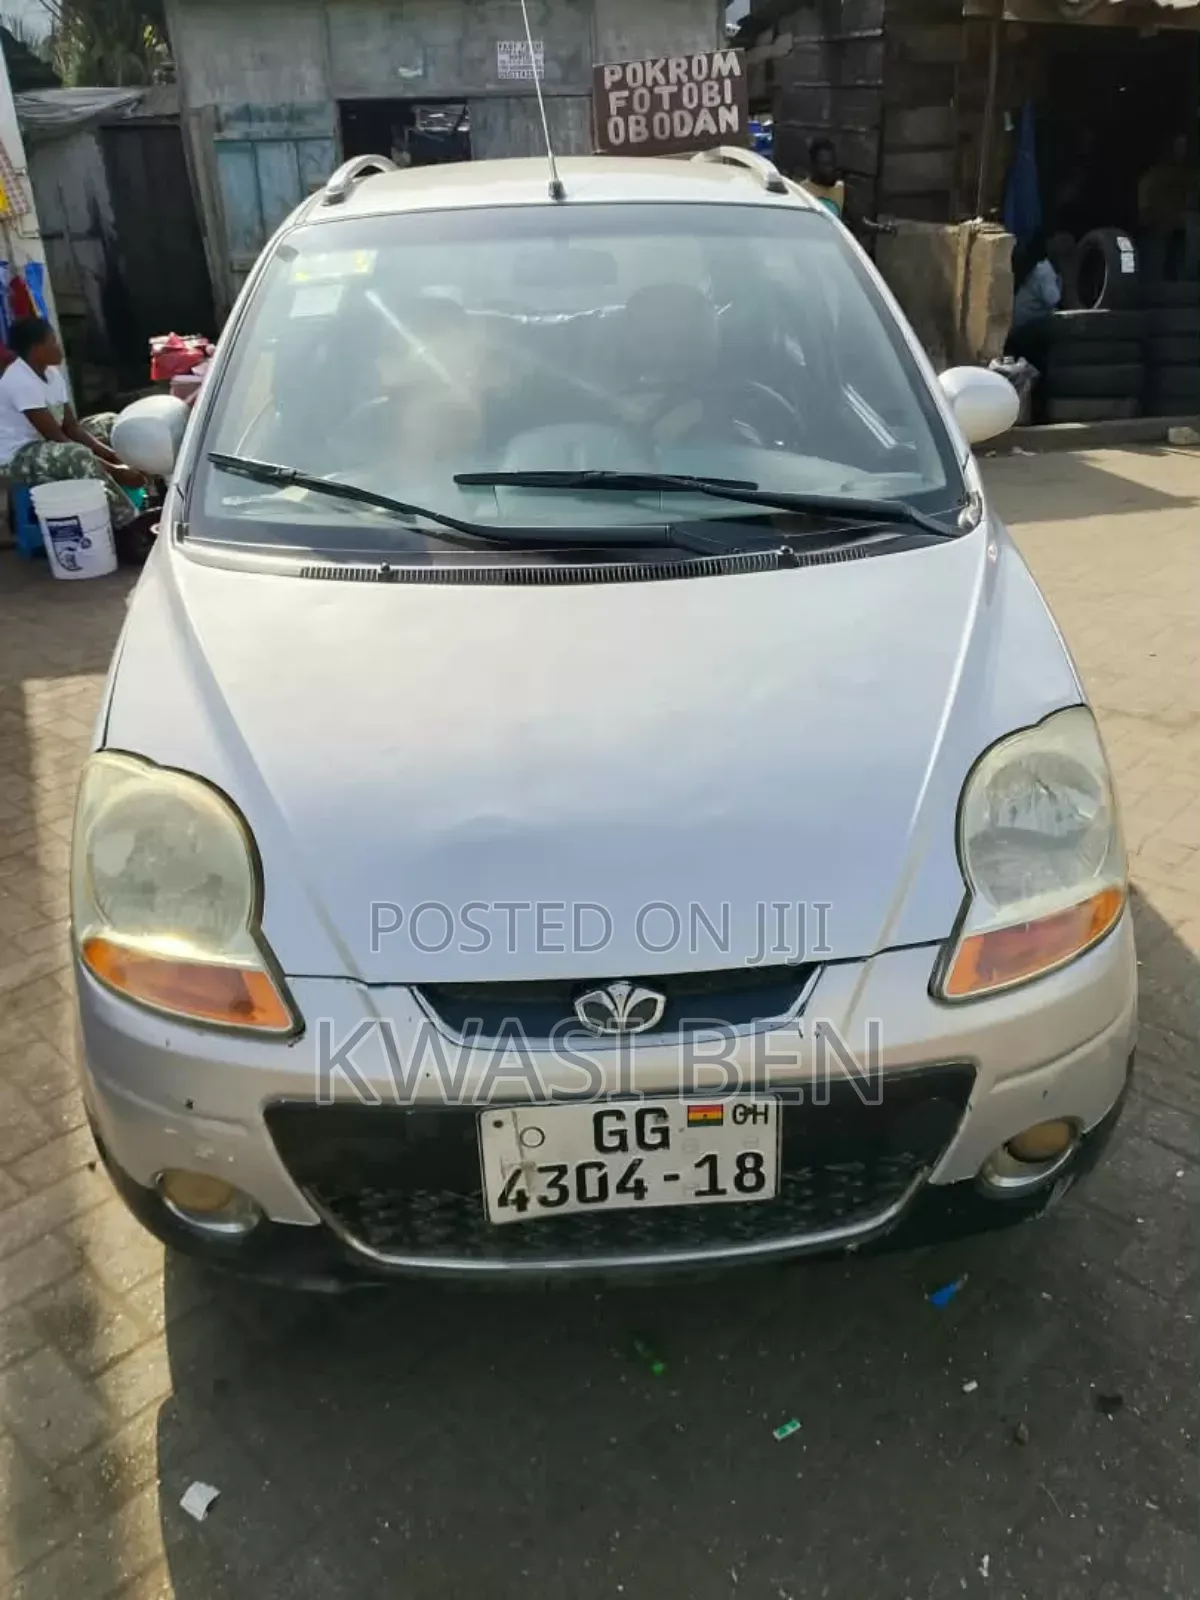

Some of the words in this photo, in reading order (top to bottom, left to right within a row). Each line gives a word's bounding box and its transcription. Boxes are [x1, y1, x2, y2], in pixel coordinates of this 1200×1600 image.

[603, 51, 742, 90] POKROM
[608, 78, 732, 116] FOTOBI
[607, 104, 739, 145] OBODAN
[592, 1106, 672, 1155] GG
[497, 1151, 766, 1213] 4304-18
